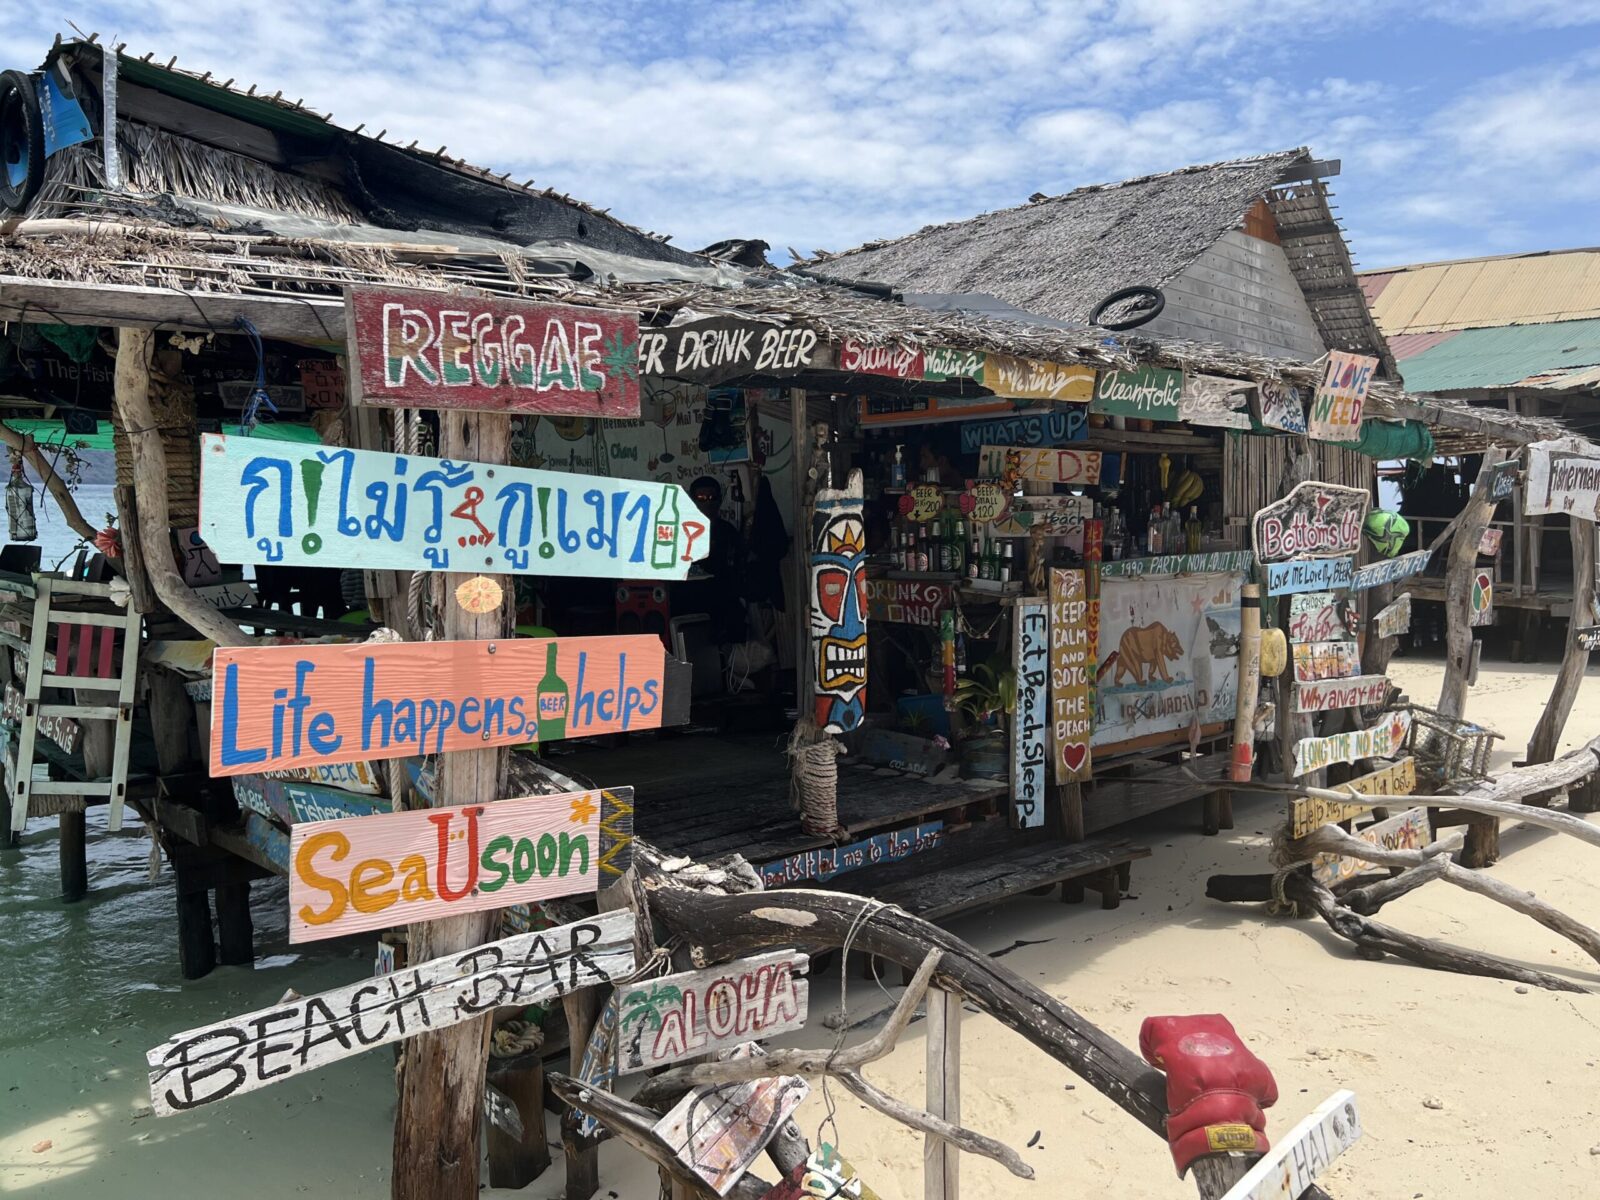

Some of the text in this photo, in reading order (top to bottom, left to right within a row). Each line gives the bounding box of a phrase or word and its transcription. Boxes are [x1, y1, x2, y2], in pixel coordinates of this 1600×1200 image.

[382, 303, 606, 393] REGGAE
[674, 328, 753, 371] DRINK
[754, 327, 818, 370] BEER
[1321, 360, 1371, 395] I LOVE
[1314, 394, 1363, 426] WEED
[965, 410, 1085, 448] WHAT'S UP
[1085, 452, 1101, 484] 420
[974, 496, 998, 505] SMALL
[976, 486, 994, 497] BEER
[924, 500, 941, 513] 200
[977, 505, 995, 518] 120
[1263, 509, 1360, 557] Bottoms Up
[1121, 561, 1143, 577] 1990
[1149, 555, 1186, 575] PARTY
[1187, 552, 1208, 573] NOW
[1333, 560, 1352, 583] BEER
[1051, 602, 1087, 624] KEEP
[1053, 628, 1087, 649] CALM
[1061, 651, 1084, 664] AND
[220, 659, 343, 766] Life
[540, 693, 566, 712] BEER
[573, 651, 658, 731] helps
[1056, 696, 1085, 716] THE
[1300, 686, 1327, 710] Why
[1056, 719, 1090, 740] BEACH
[1301, 727, 1390, 770] LONG TIME NO SEE
[1296, 797, 1324, 836] Help
[164, 924, 611, 1111] BEACH BAR
[652, 961, 798, 1060] ALOHA
